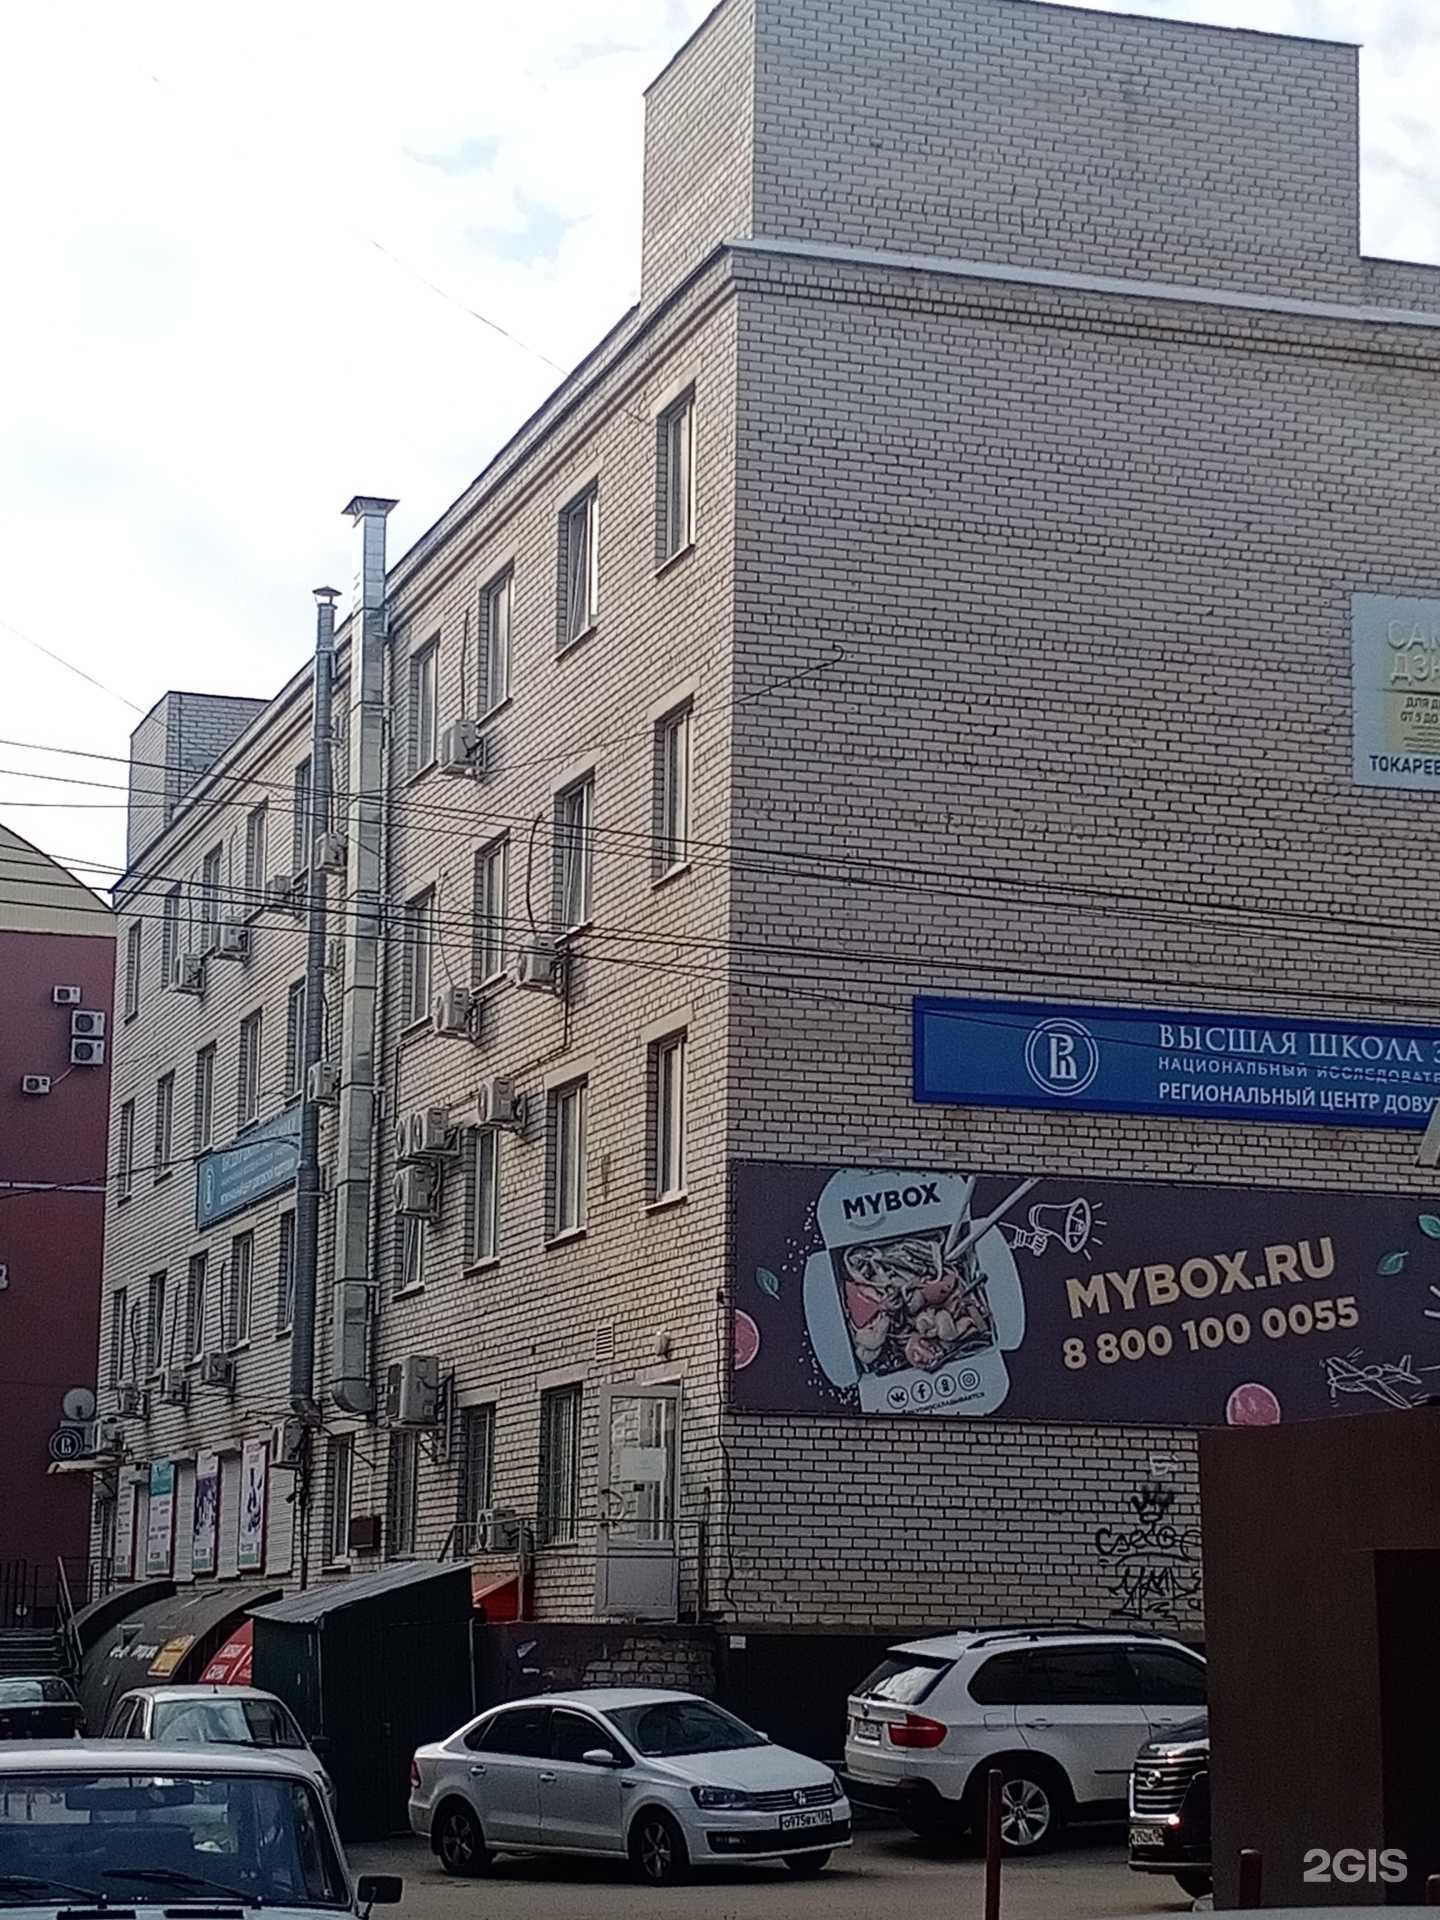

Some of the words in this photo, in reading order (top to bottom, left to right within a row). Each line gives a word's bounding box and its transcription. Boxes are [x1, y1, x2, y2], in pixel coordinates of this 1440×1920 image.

[1159, 1023, 1297, 1055] ВЫСШАЯ
[1309, 1033, 1424, 1062] ШКОЛА
[1158, 1056, 1308, 1077] НАЦИОНАЛЬНЫЙ
[1159, 1082, 1316, 1107] РЕГИОНАЛЬНЫЙ
[1320, 1090, 1380, 1111] ЦЕНТР
[842, 1182, 941, 1219] MYBOX
[1066, 1237, 1335, 1319] MYBOX.RU
[1063, 1338, 1087, 1369] 8
[1096, 1324, 1173, 1364] 800
[1181, 1313, 1251, 1352] 100
[1262, 1297, 1360, 1339] 0055
